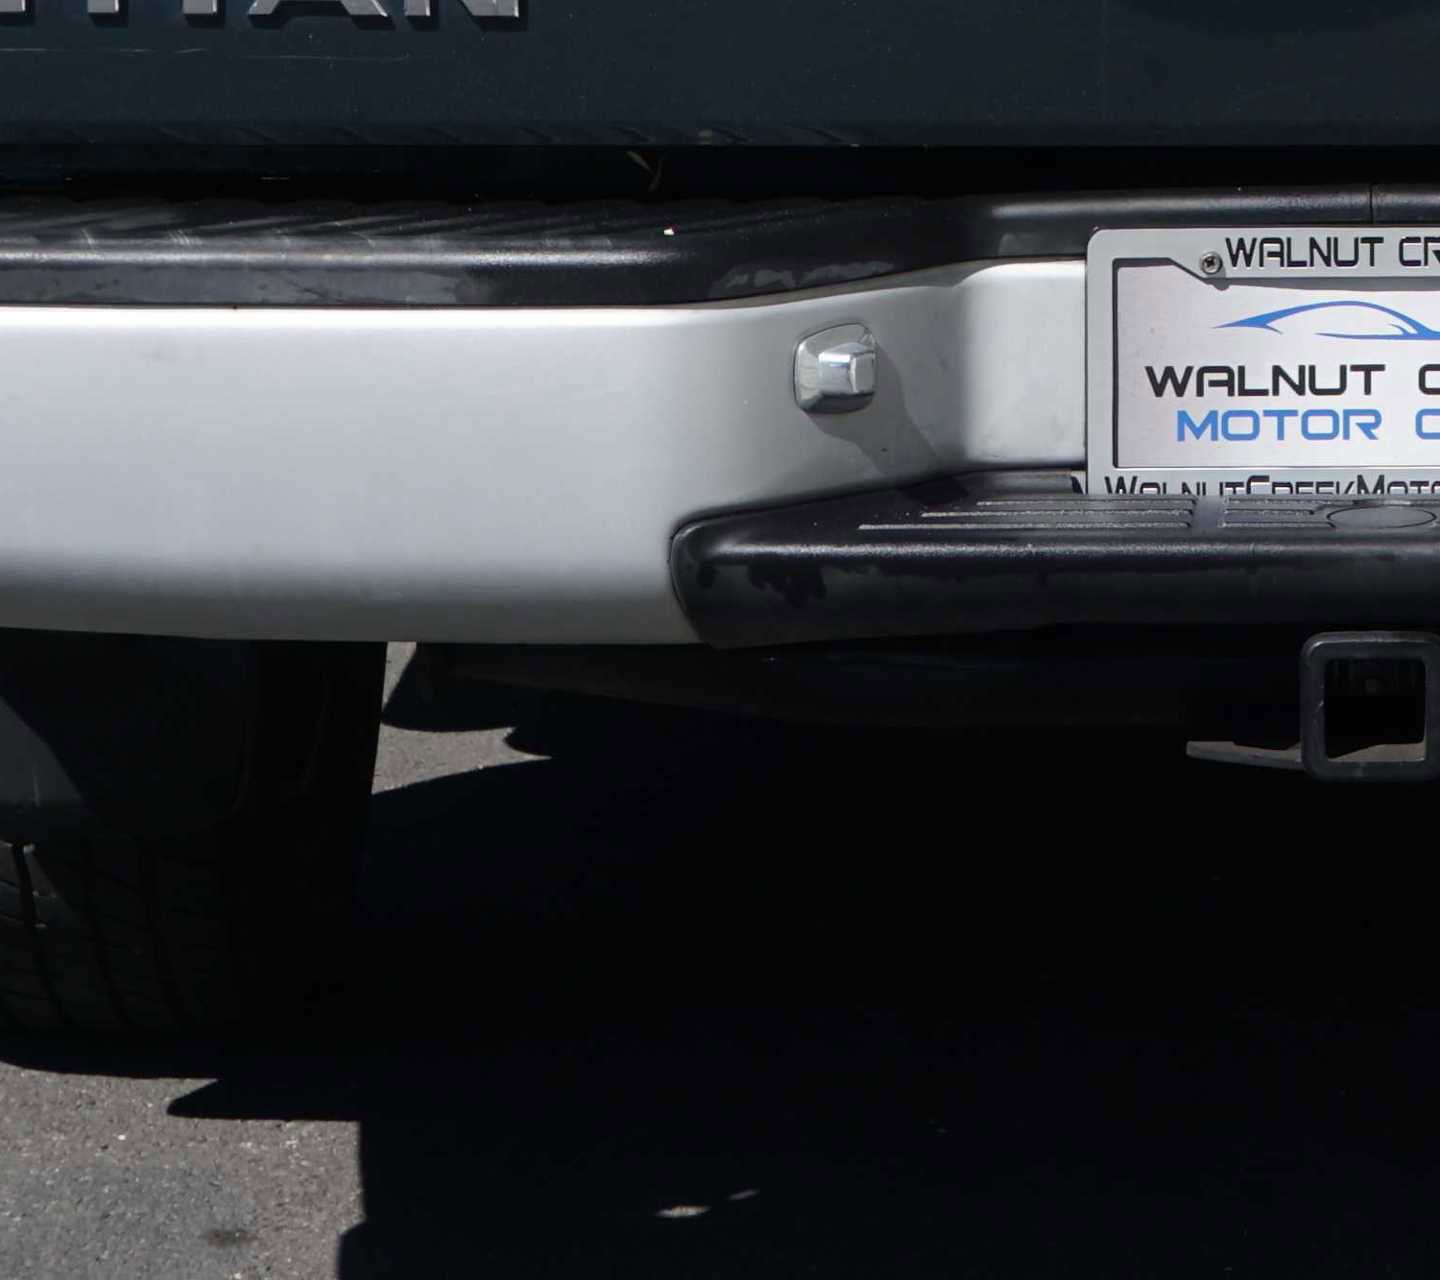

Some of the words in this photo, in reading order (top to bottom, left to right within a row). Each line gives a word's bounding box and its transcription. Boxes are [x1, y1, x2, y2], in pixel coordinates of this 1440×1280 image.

[1226, 236, 1384, 268] WALNUT
[1145, 365, 1386, 397] WALNUT
[1176, 408, 1382, 441] MOTOR
